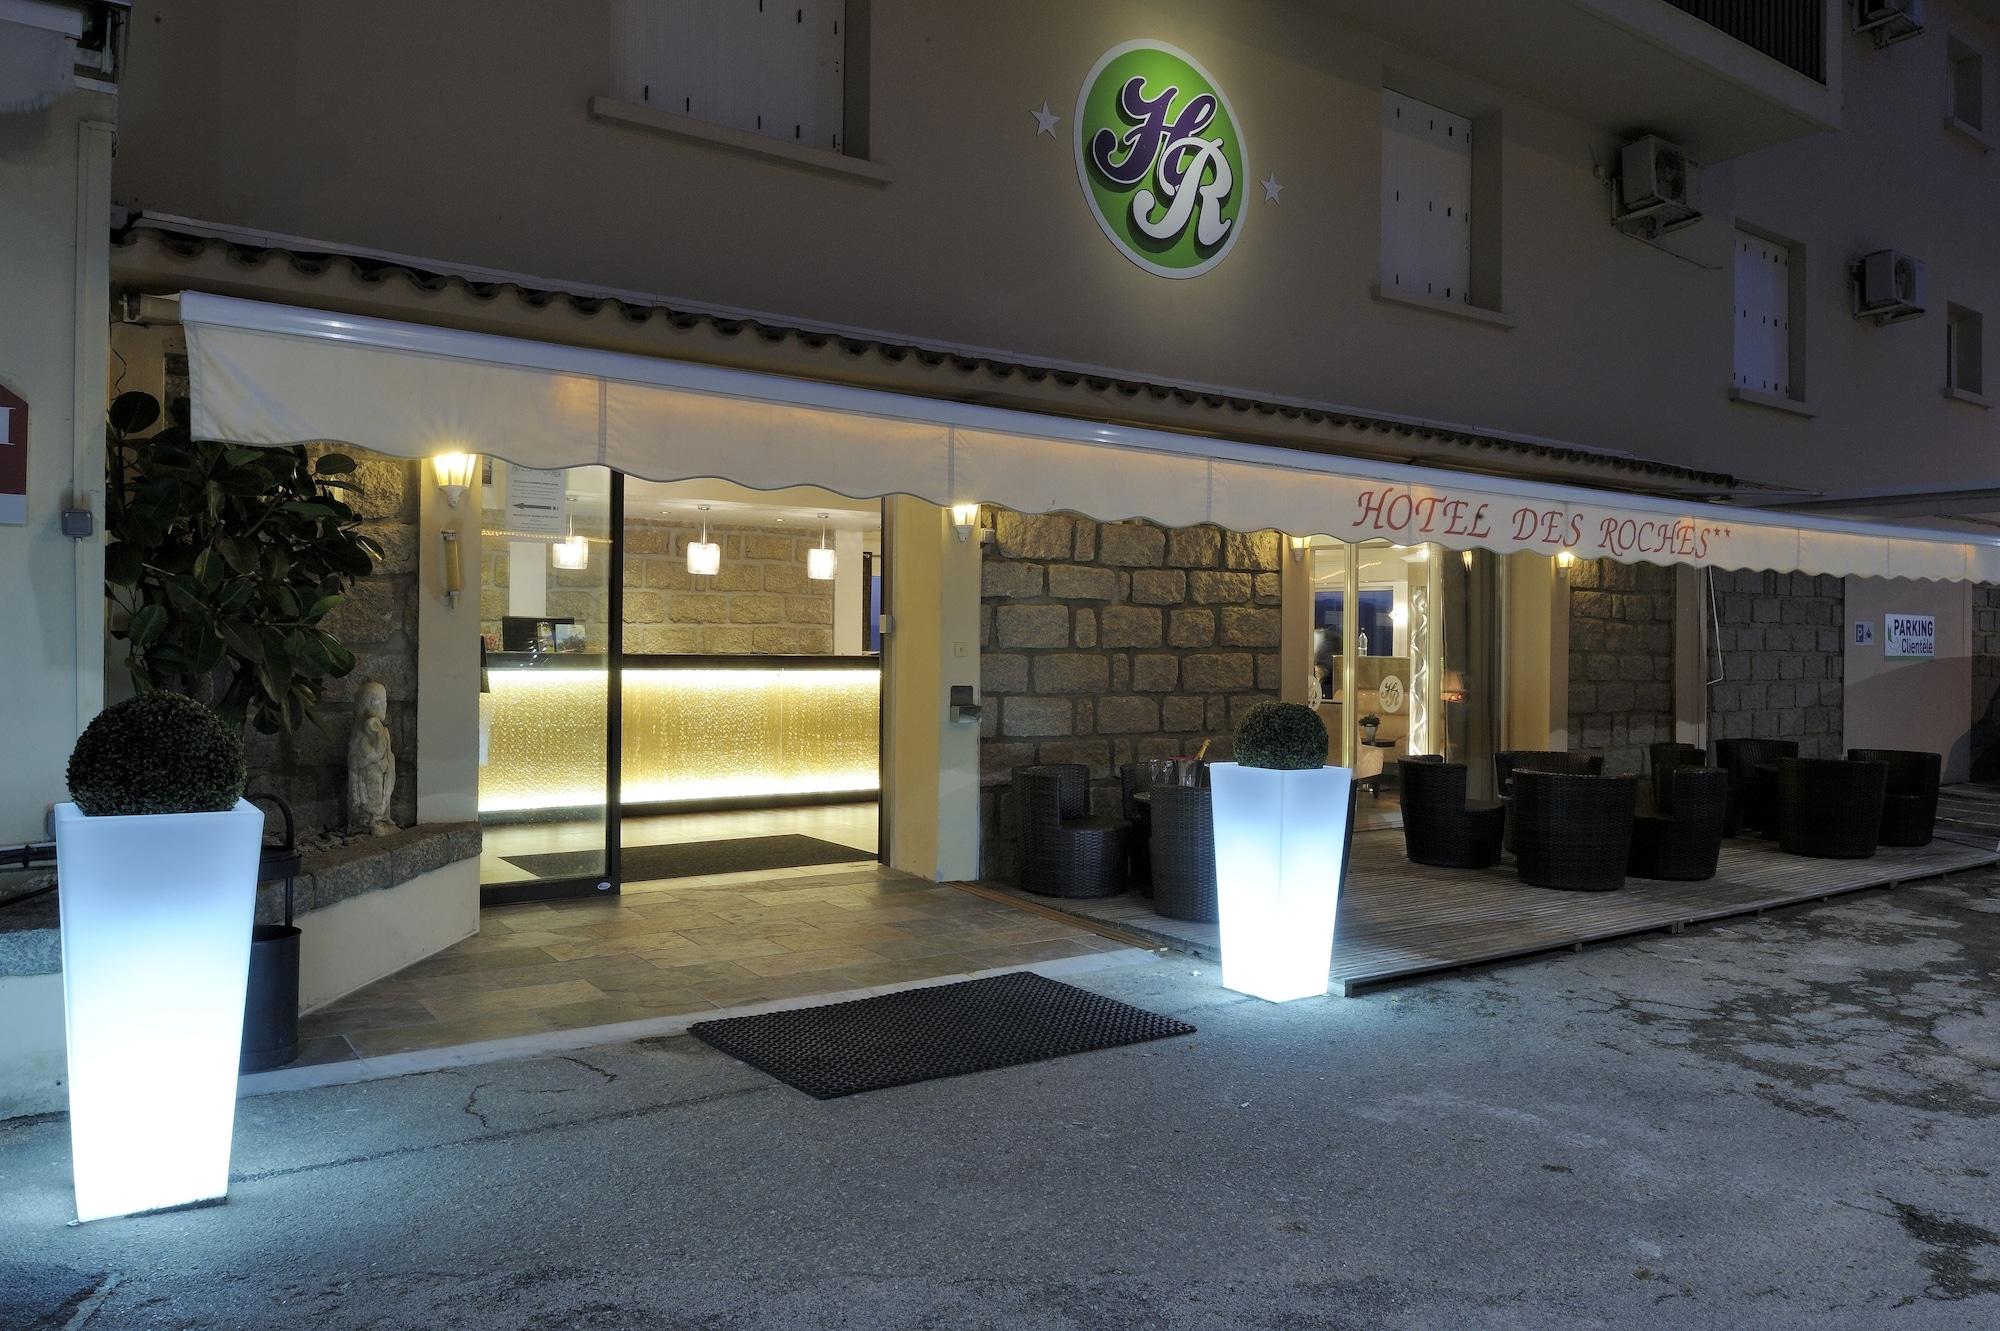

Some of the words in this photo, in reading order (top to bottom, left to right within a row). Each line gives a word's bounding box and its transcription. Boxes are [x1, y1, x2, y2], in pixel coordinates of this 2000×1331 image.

[1352, 487, 1491, 539] HOTEL
[1512, 507, 1584, 548] DES
[1893, 619, 1933, 637] PARKING
[1901, 637, 1933, 654] Clientèle
